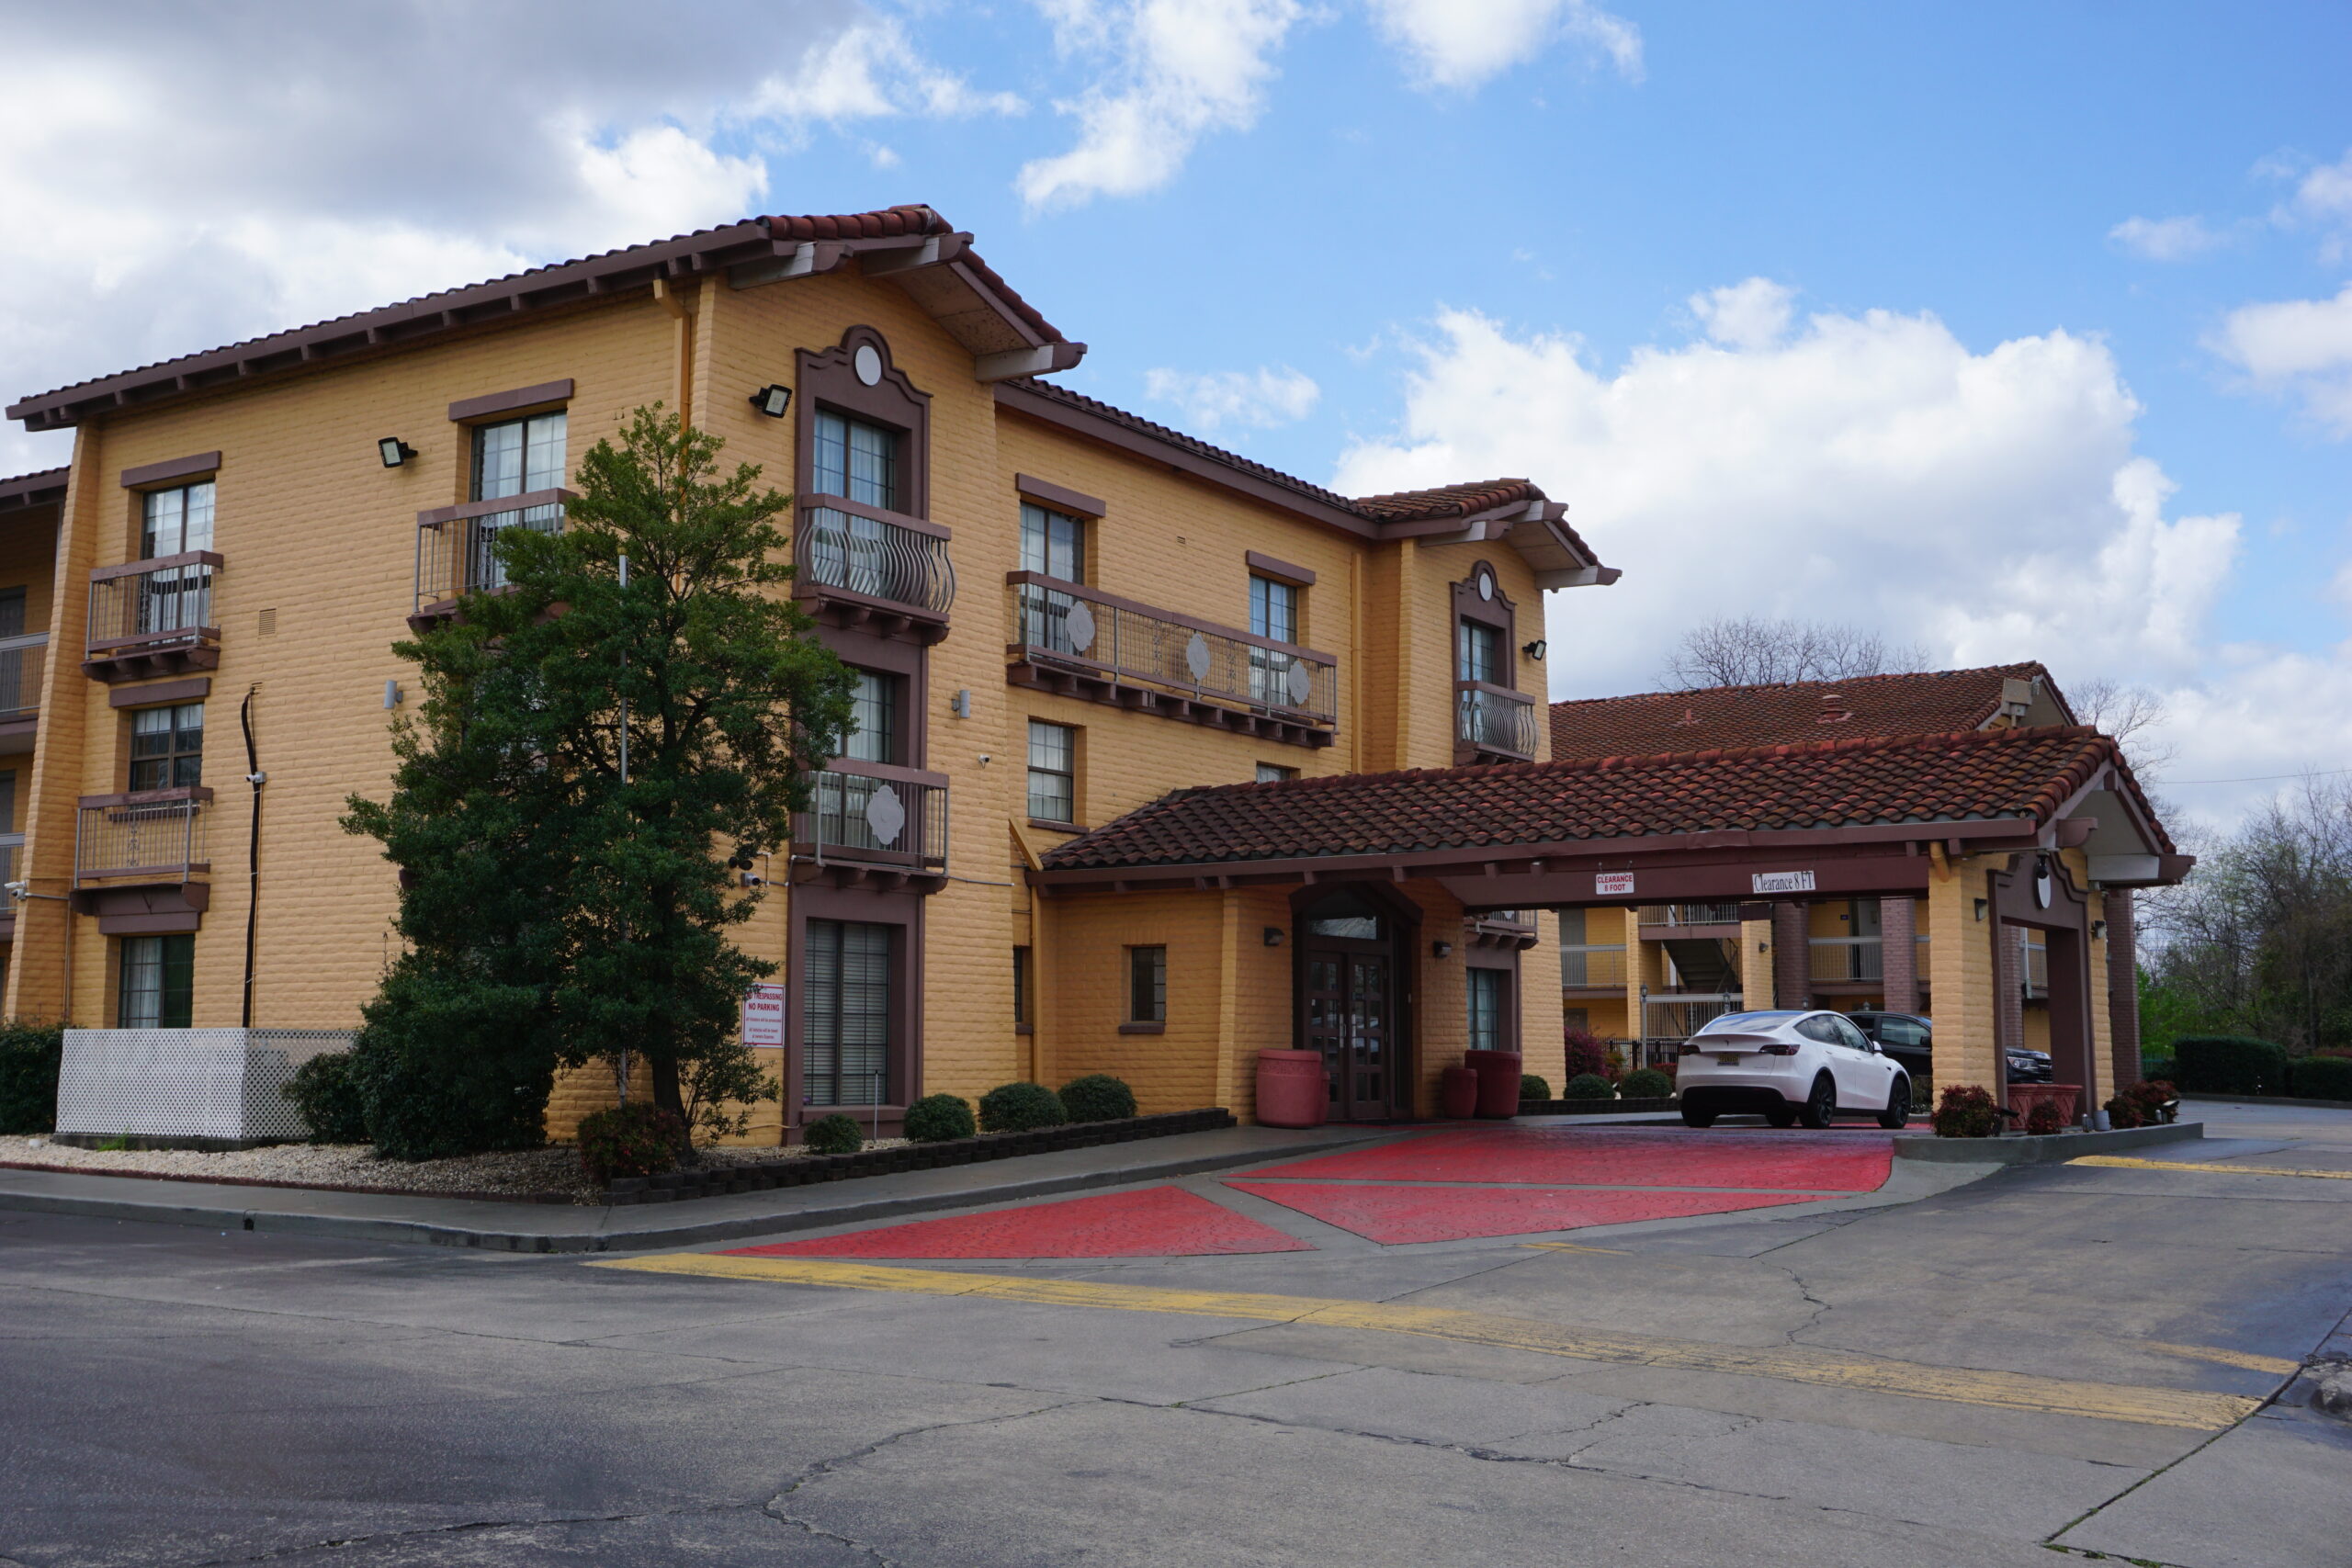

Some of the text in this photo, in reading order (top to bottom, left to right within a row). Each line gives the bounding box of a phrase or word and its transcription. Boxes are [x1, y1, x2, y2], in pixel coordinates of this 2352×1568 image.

[1597, 874, 1633, 884] CLEARANCE
[1754, 872, 1813, 892] Clearance 8 FT
[1610, 884, 1626, 892] FOOT
[753, 992, 783, 1000] TRESPASSING
[748, 1002, 780, 1011] NO PARKING
